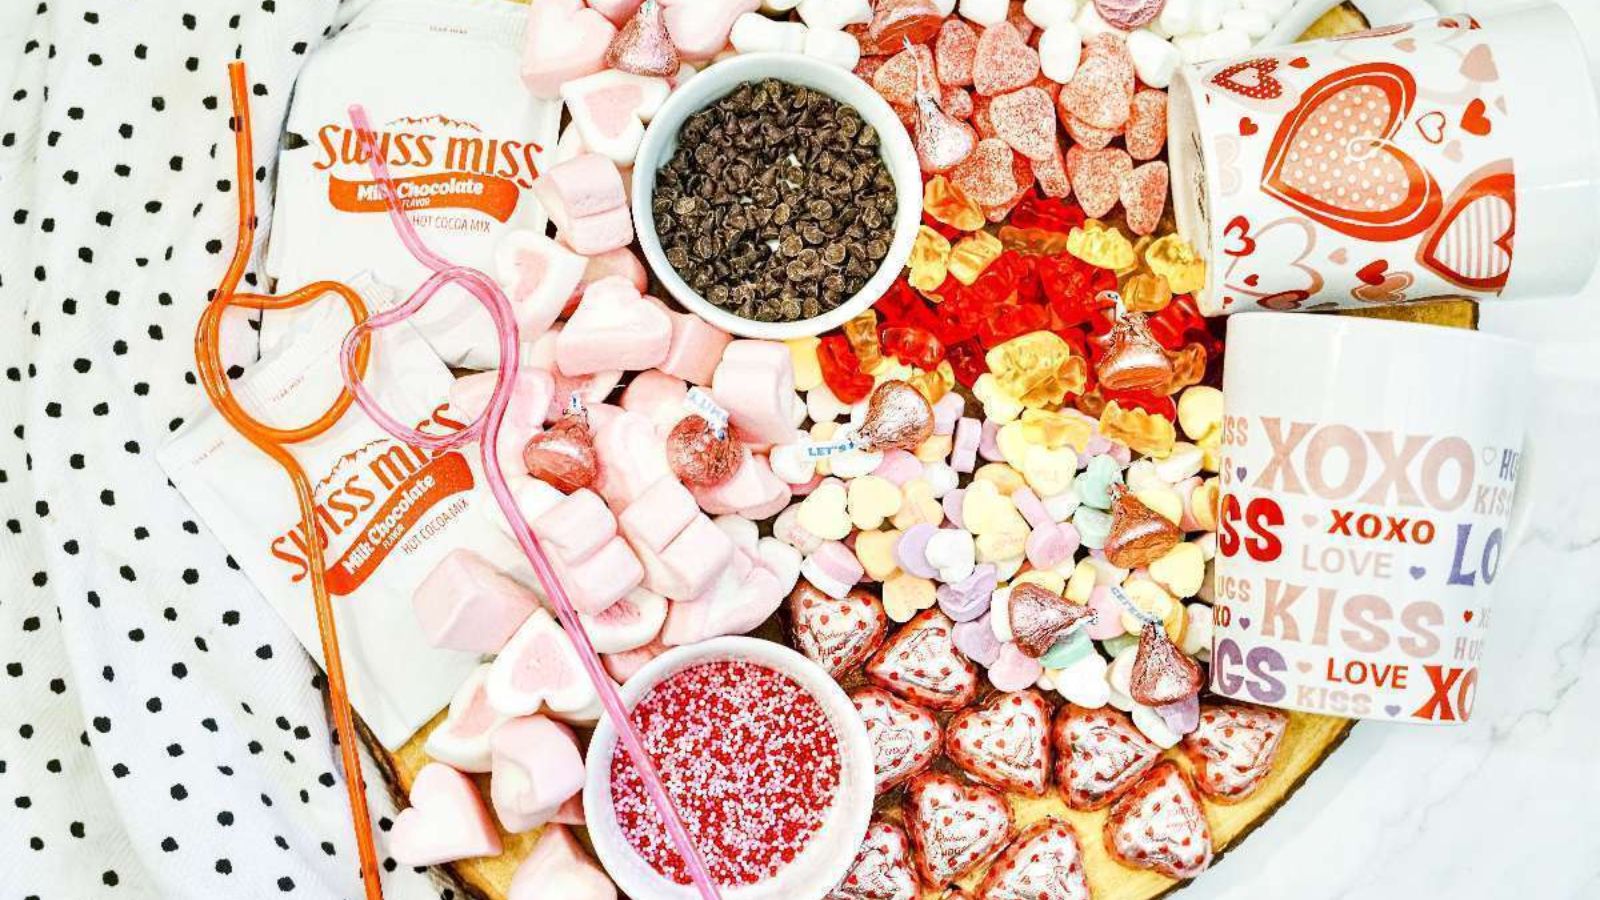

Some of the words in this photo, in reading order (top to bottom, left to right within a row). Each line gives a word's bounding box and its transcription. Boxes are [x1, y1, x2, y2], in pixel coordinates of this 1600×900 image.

[396, 178, 484, 199] Chocolate
[412, 215, 433, 227] HOT
[435, 216, 468, 230] COCOA
[470, 219, 490, 233] MIX
[1251, 416, 1475, 513] XOXO
[341, 539, 375, 575] Milk
[367, 473, 435, 545] Chocolate
[400, 535, 422, 556] HOT
[420, 509, 454, 540] COCOA
[1219, 493, 1285, 562] SS
[1327, 509, 1435, 545] XOXO
[1446, 524, 1503, 586] LO
[1302, 545, 1392, 579] LOVE
[1217, 576, 1251, 602] UGS
[1260, 578, 1445, 659] KISS
[1297, 685, 1372, 715] KISS
[1326, 657, 1409, 689] LOVE
[1410, 664, 1478, 722] XO
